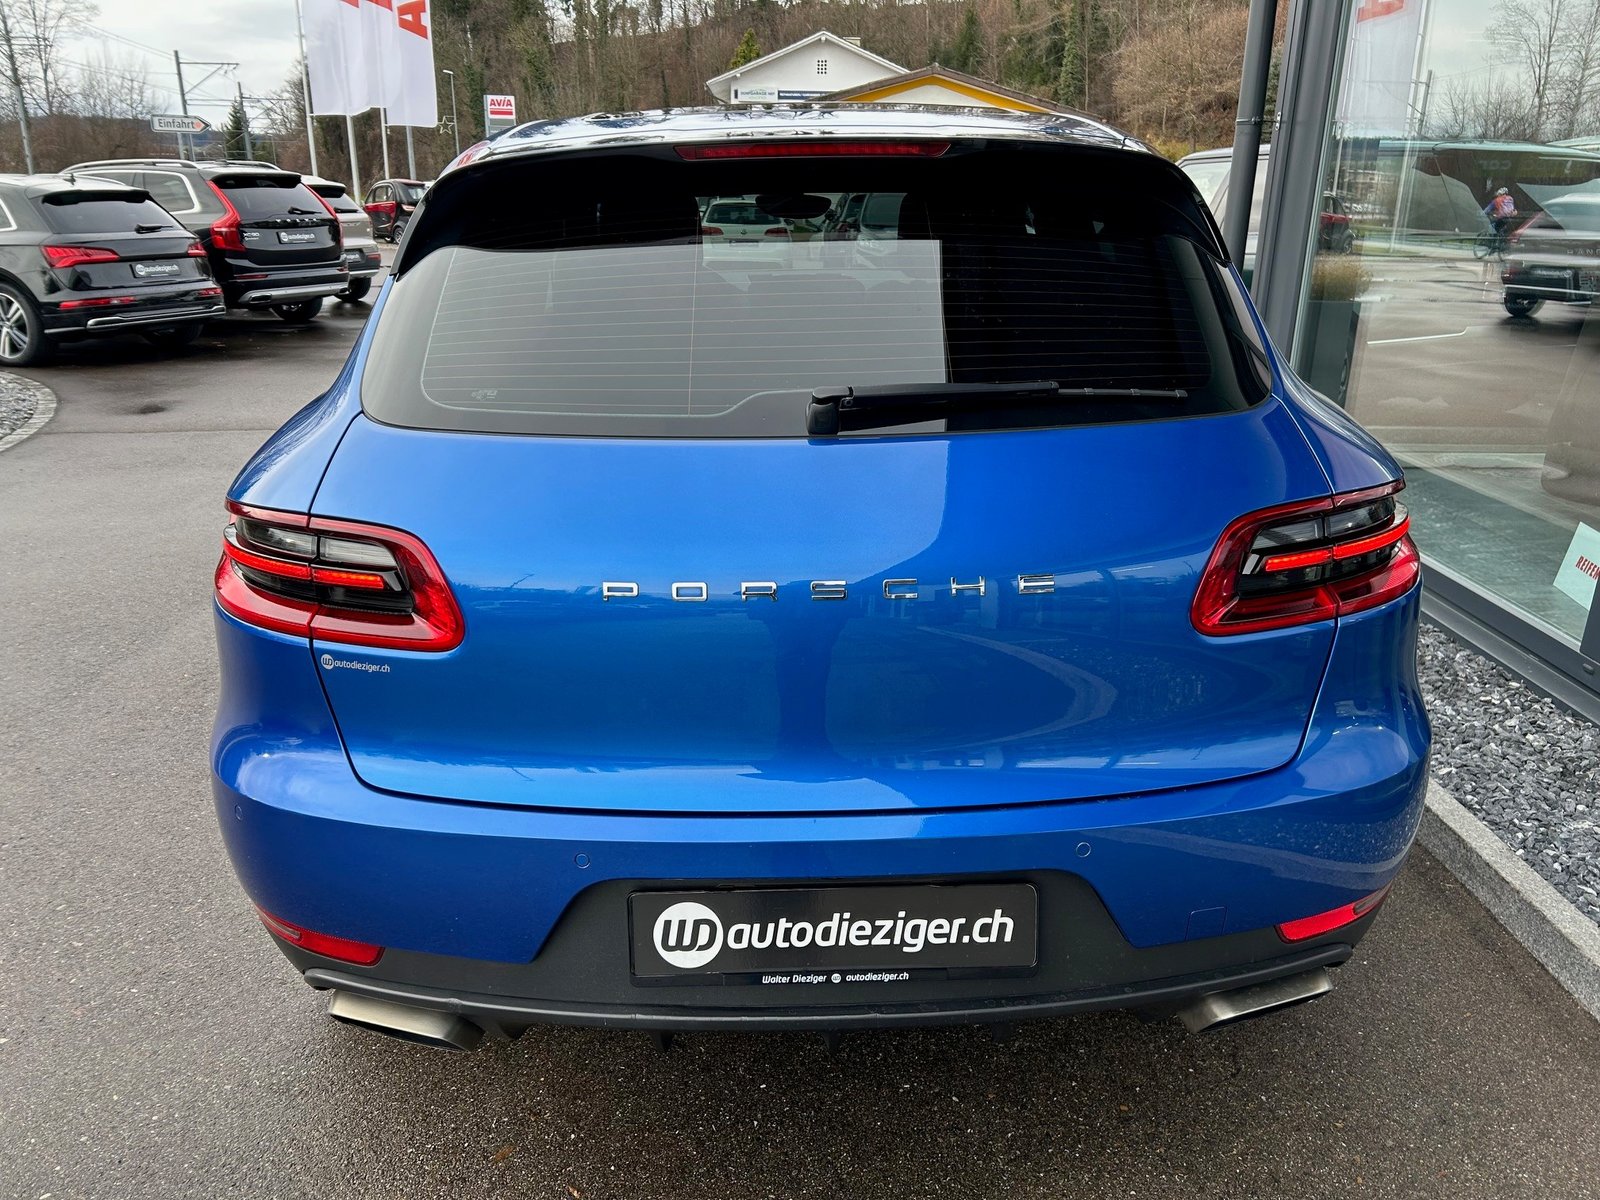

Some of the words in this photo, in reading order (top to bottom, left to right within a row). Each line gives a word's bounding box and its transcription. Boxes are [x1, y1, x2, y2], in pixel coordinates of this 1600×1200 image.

[157, 118, 195, 129] Einfahrt
[602, 574, 1056, 602] PORSCHE
[334, 660, 391, 673] autodieziger.ch
[727, 908, 1015, 953] autodieziger.ch
[762, 975, 790, 984] Walter
[792, 974, 827, 984] Dieziger
[845, 972, 909, 982] autodieziger.ch
